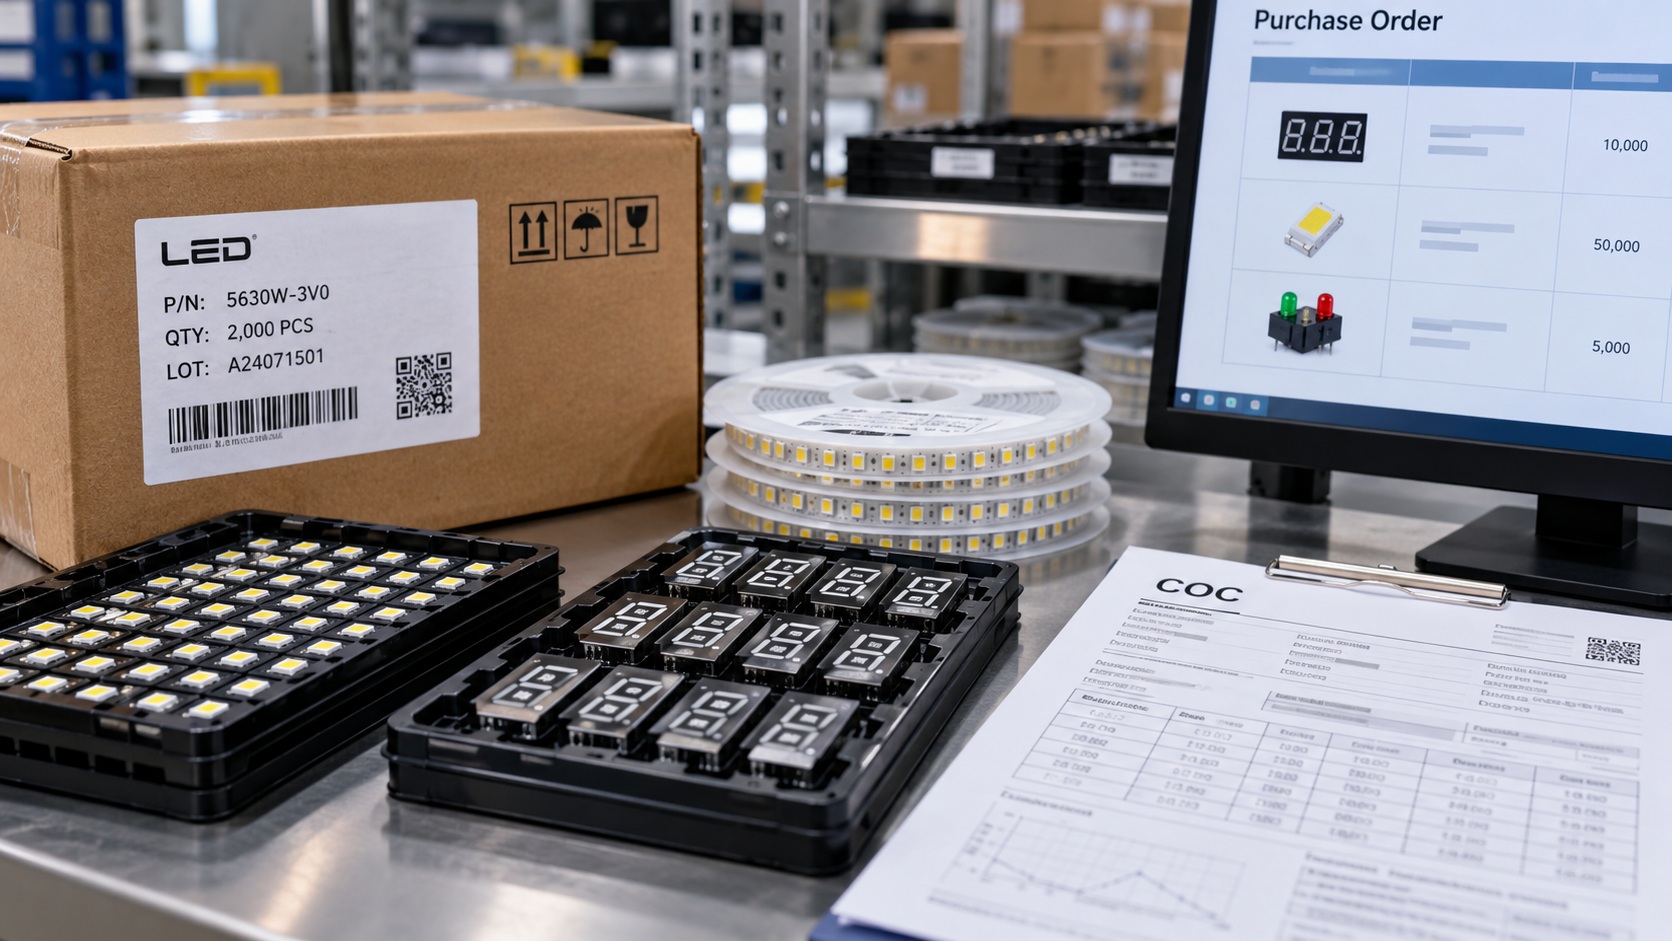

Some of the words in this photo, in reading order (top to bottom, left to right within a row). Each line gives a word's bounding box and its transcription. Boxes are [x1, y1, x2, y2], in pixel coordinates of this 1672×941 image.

[1254, 9, 1363, 31] Purchase
[1370, 9, 1444, 32] Order
[1603, 137, 1649, 153] 10,000
[160, 236, 252, 267] LED
[1593, 237, 1640, 254] 50,000
[163, 294, 206, 314] P/N:
[226, 284, 330, 308] 5630W-3V0
[165, 326, 210, 347] QTY:
[227, 320, 275, 342] 2,000
[280, 317, 314, 337] PCS
[1592, 339, 1631, 355] 5,000
[167, 360, 210, 381] LOT:
[227, 348, 324, 374] A24071501
[1155, 577, 1244, 603] COC
